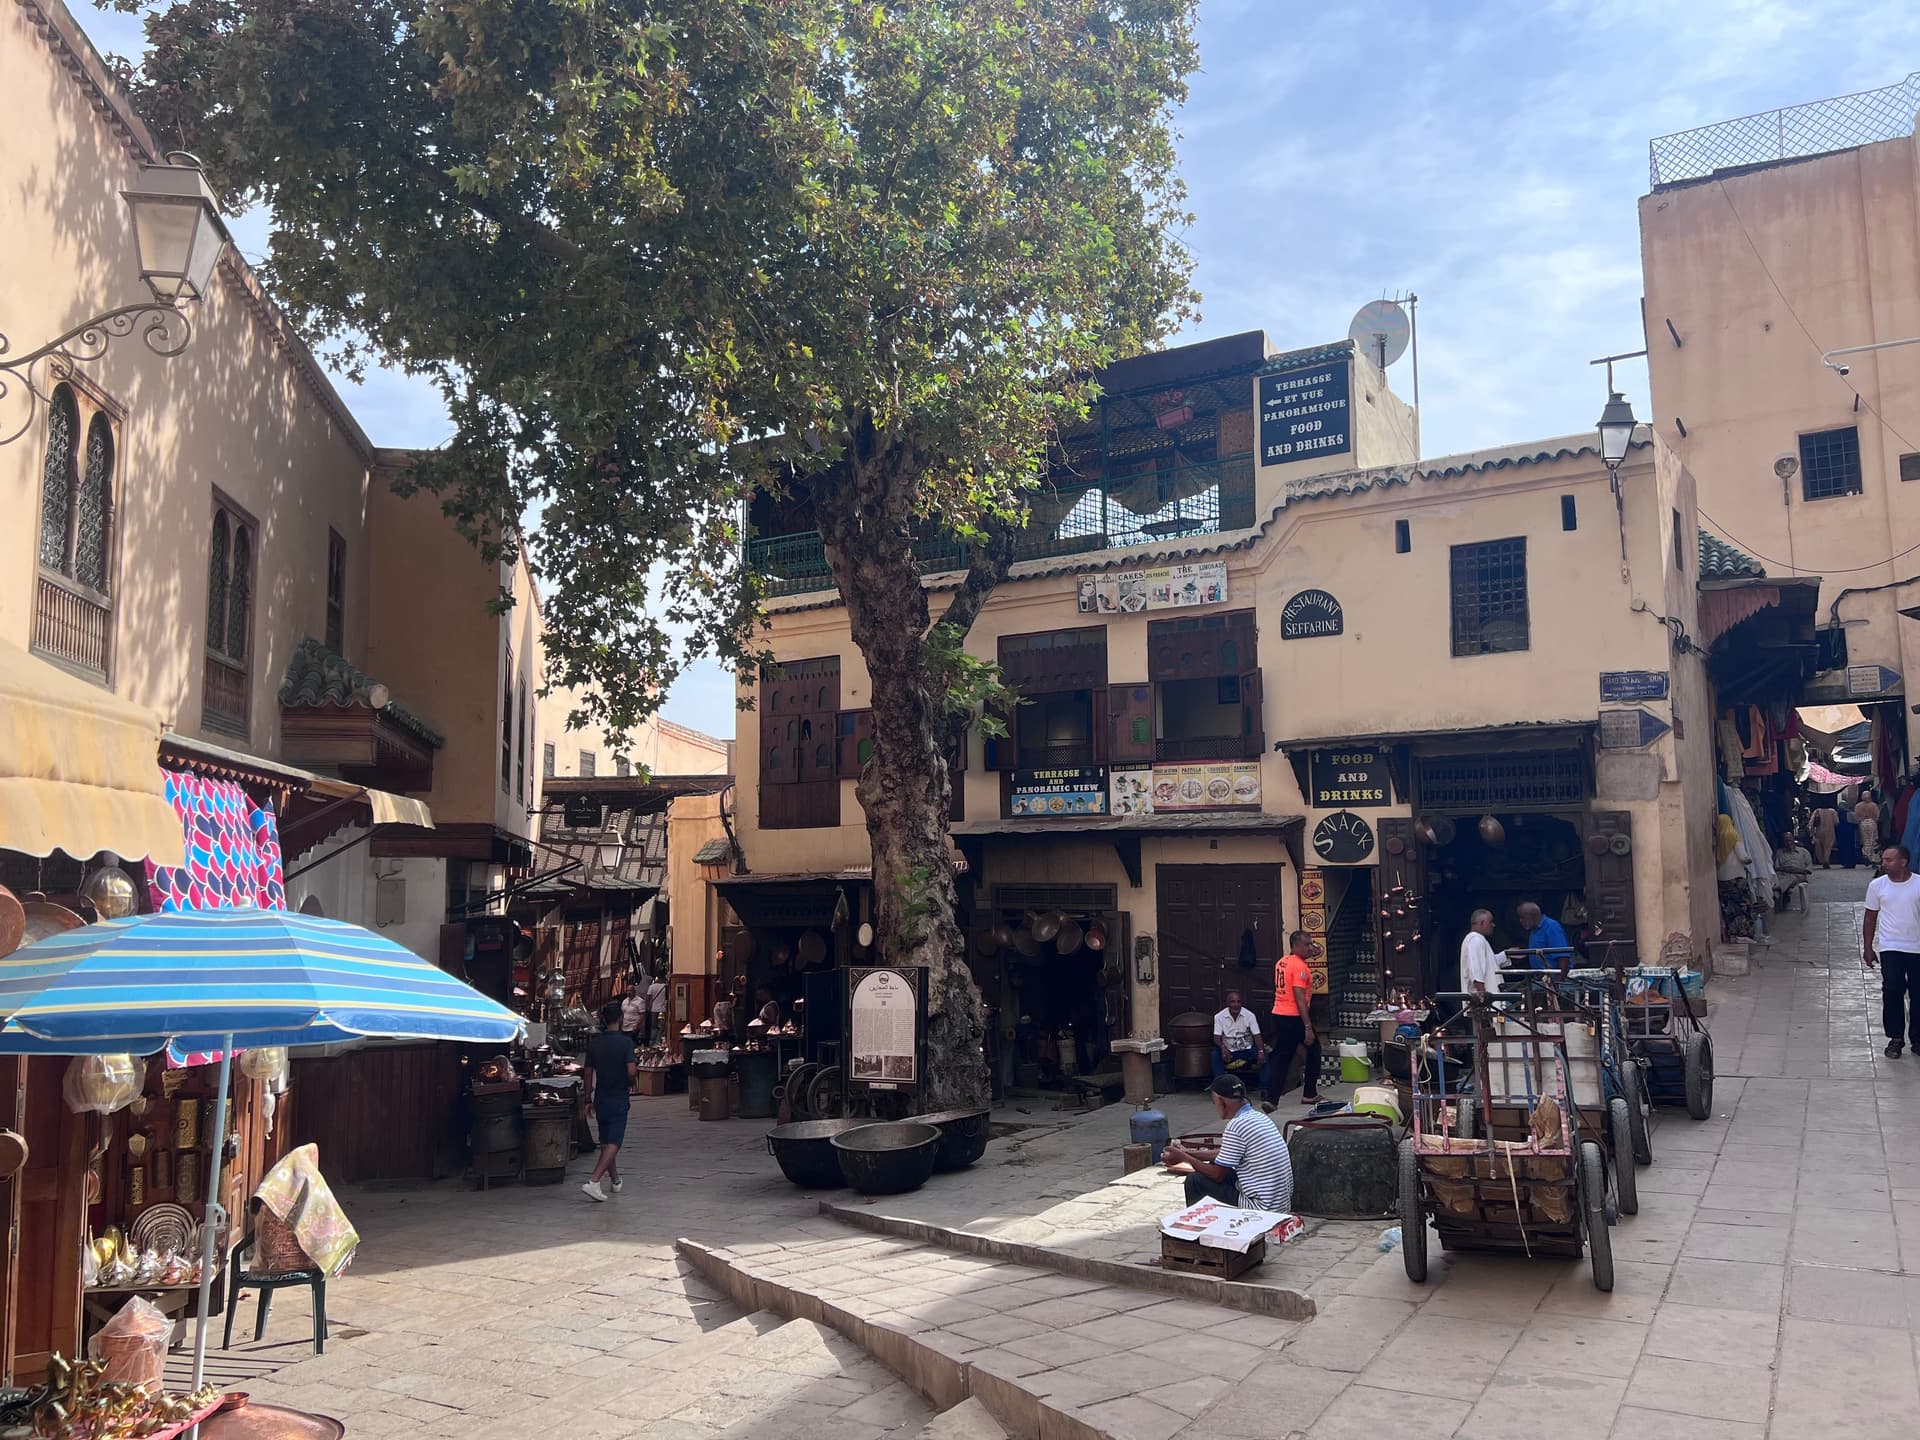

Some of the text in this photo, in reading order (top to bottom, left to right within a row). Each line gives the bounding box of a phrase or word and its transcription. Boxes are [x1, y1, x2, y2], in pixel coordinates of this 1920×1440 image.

[1275, 373, 1332, 391] TERRASSE
[1284, 389, 1324, 404] ET VUE
[1263, 399, 1346, 422] PANORAMIQUE
[1290, 420, 1322, 435] FOOD
[1267, 434, 1344, 457] AND DRINKS
[1118, 572, 1144, 581] CAKES
[1283, 593, 1341, 622] RESTAURANT
[1285, 618, 1339, 636] SEFFARINE
[1331, 753, 1374, 766] FOOD
[1033, 769, 1080, 779] TERRASSE
[1337, 772, 1368, 783] AND
[1016, 785, 1070, 794] PANORAMIC
[1320, 789, 1384, 801] DRINKS
[1313, 814, 1373, 855] SNACK
